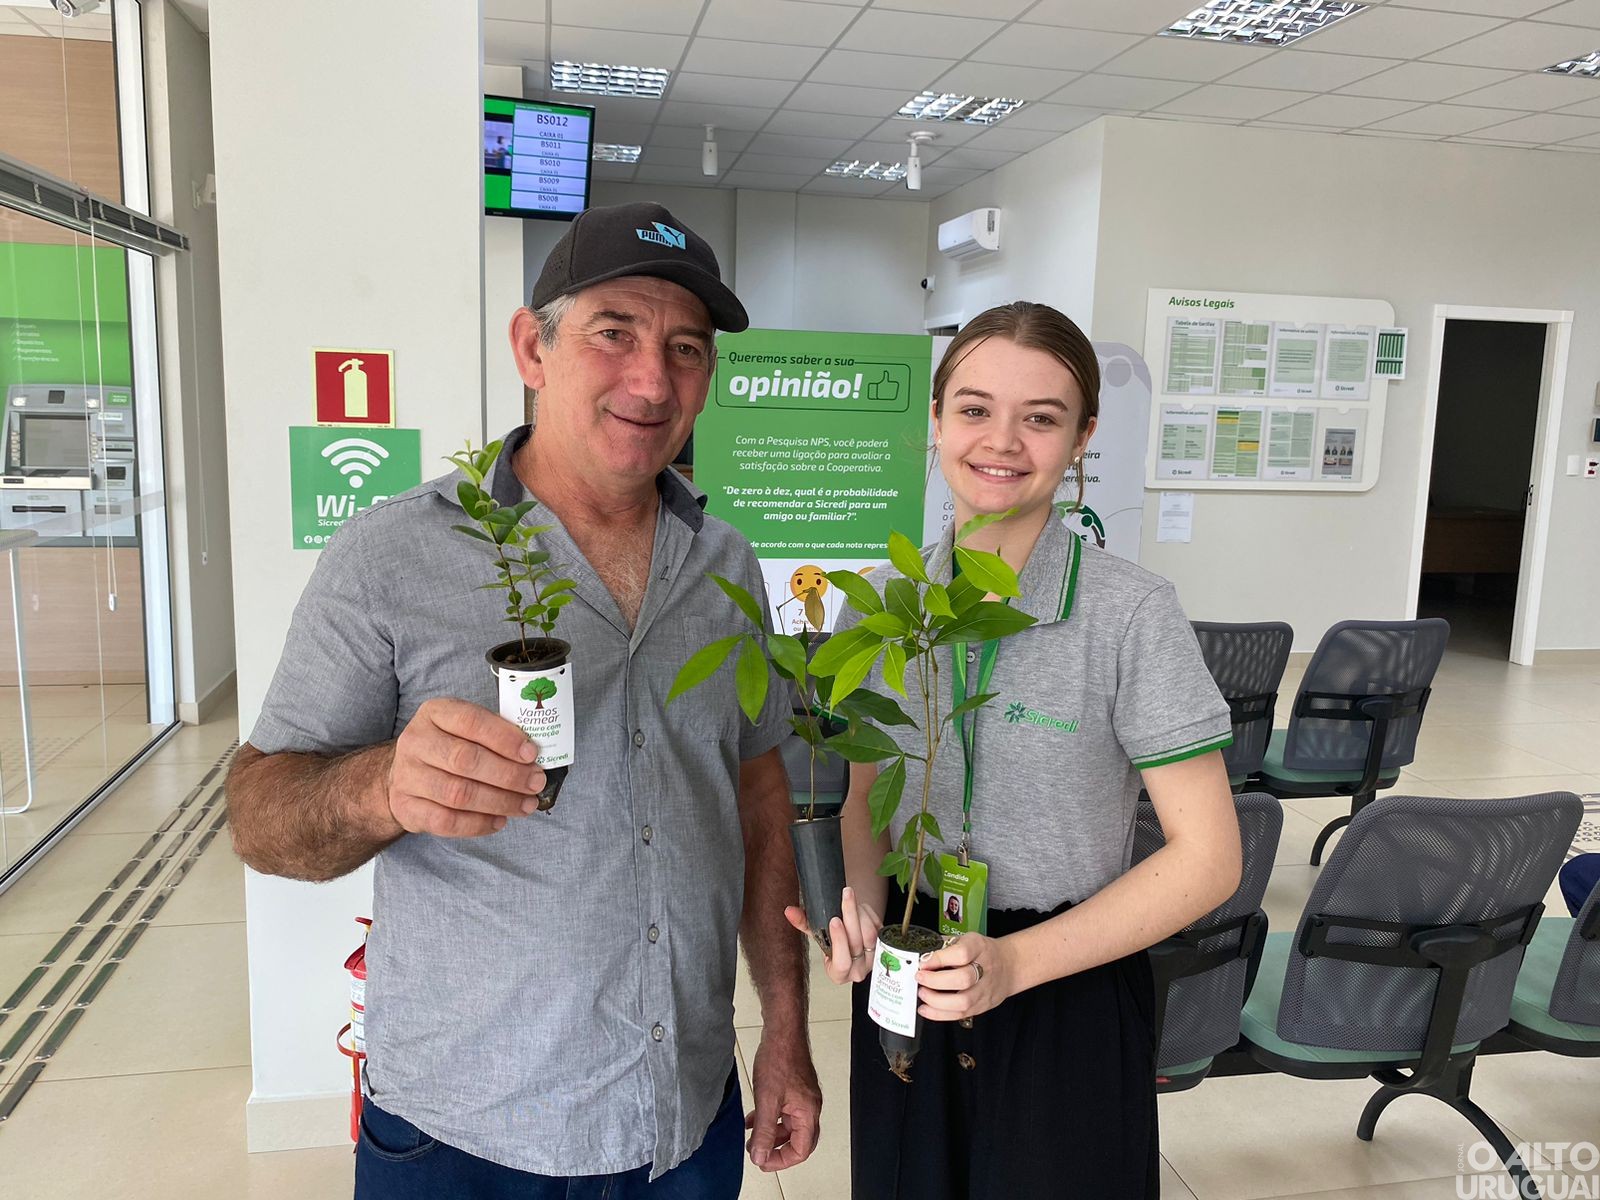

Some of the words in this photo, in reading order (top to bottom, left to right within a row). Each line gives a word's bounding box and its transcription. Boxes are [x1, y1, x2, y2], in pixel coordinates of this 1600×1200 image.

[536, 114, 568, 127] BS012
[541, 141, 561, 149] BS011
[540, 159, 560, 167] BS010
[539, 177, 560, 185] BS009
[538, 195, 559, 203] BS008
[1168, 296, 1201, 307] Avisos
[1203, 298, 1235, 310] Legais
[728, 352, 787, 364] Queremos
[790, 355, 822, 365] saber
[834, 358, 855, 366] sua
[729, 369, 863, 402] opinião!
[735, 435, 757, 445] Com
[758, 437, 765, 445] a
[767, 436, 809, 447] Pesquisa
[810, 437, 831, 447] NPS,
[833, 437, 855, 448] você
[856, 439, 889, 449] poderá
[732, 449, 768, 458] receber
[792, 449, 826, 461] ligação
[828, 451, 850, 461] para
[851, 451, 883, 461] avaliar
[739, 461, 788, 472] satisfação
[790, 462, 817, 472] sobre
[818, 464, 825, 472] a
[826, 462, 883, 473] Cooperativa.
[741, 488, 763, 496] zero
[765, 486, 771, 496] à
[773, 487, 793, 497] dez,
[794, 488, 816, 498] qual
[817, 487, 824, 497] é
[825, 489, 832, 497] a
[833, 488, 899, 498] probabilidade
[316, 495, 396, 517] Wi-
[733, 498, 746, 507] de
[747, 499, 806, 508] recomendar
[815, 499, 848, 509] Sicredi
[848, 502, 871, 510] para
[763, 511, 794, 522] amigo
[795, 513, 807, 521] ou
[318, 519, 346, 527] Sicred
[811, 542, 825, 550] que
[826, 541, 844, 549] cada
[864, 542, 889, 550] repres
[519, 707, 558, 717] Vamos
[516, 714, 560, 725] semear
[1026, 709, 1079, 734] Sicredi
[546, 723, 561, 731] com
[546, 753, 569, 763] Sicredi
